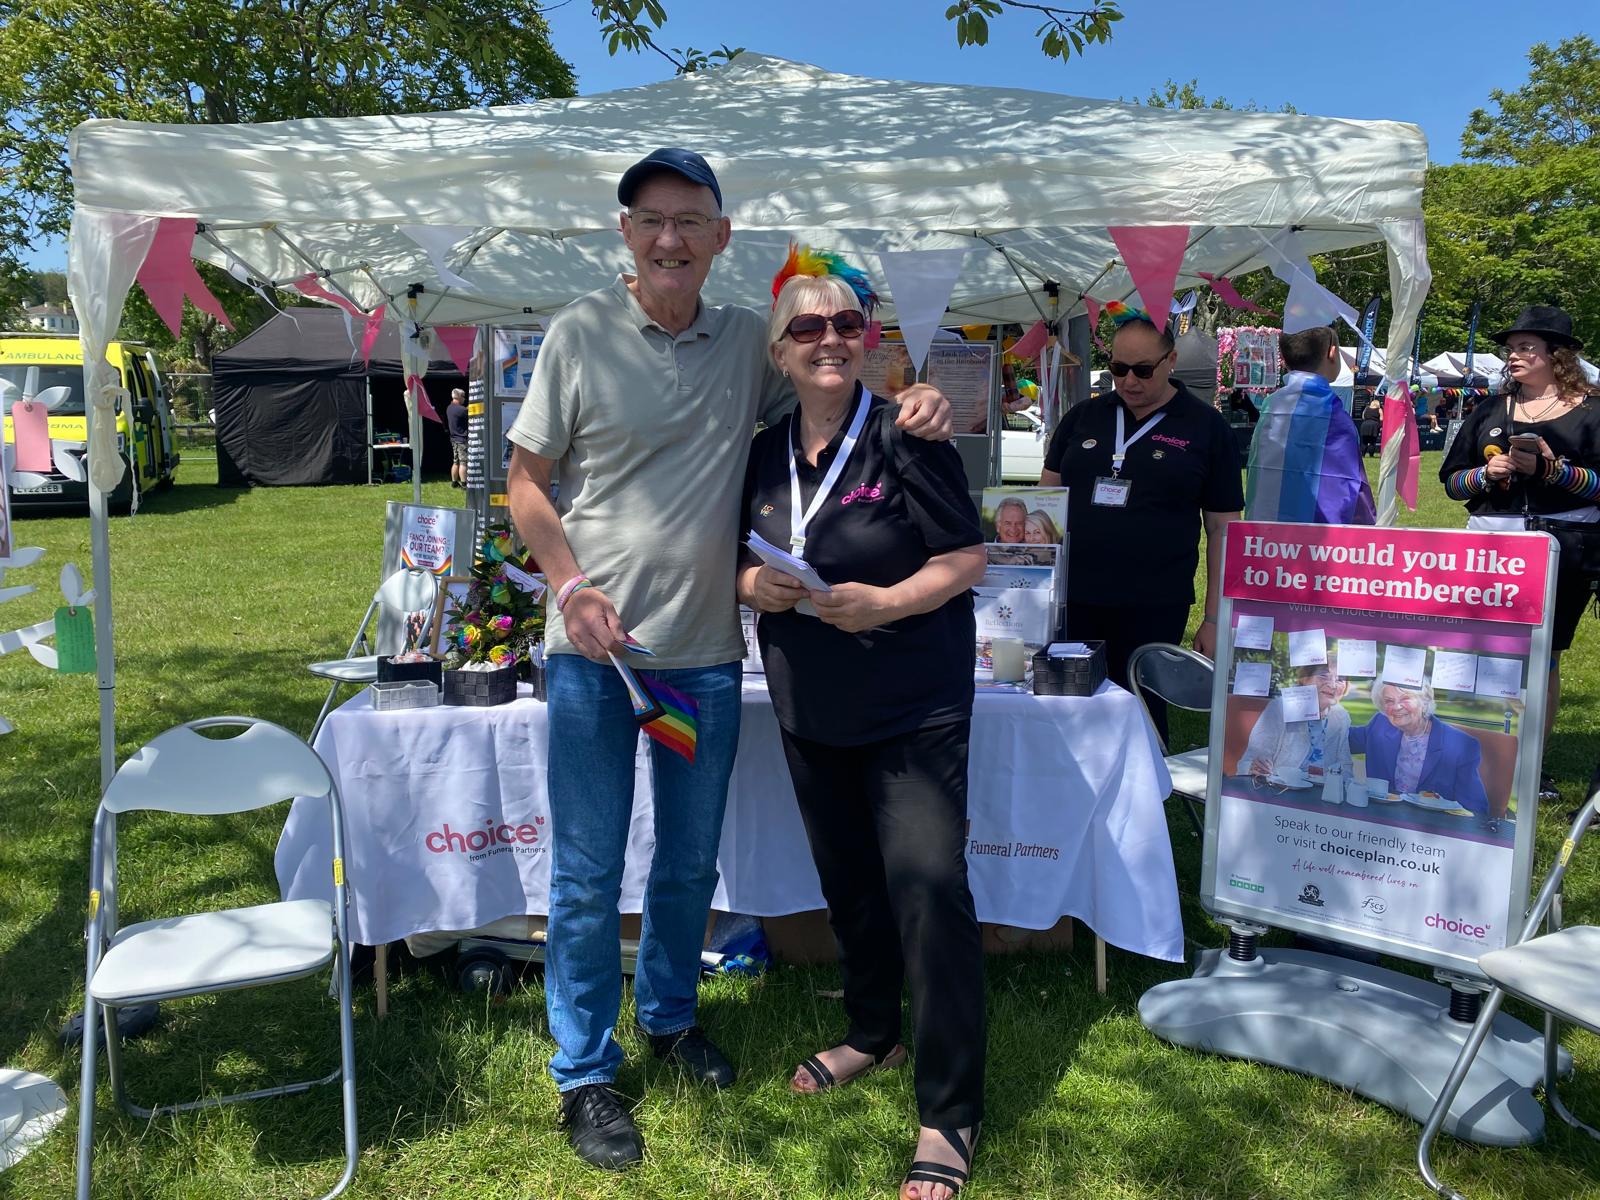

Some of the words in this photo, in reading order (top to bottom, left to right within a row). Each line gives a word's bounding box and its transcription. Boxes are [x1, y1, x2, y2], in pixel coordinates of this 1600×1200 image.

[1152, 434, 1186, 447] choice
[842, 482, 880, 504] choice
[417, 514, 435, 525] choice
[409, 533, 425, 542] FANCY
[426, 535, 447, 544] JOINING
[410, 542, 422, 551] OUR
[424, 543, 445, 555] TEAM?
[1243, 536, 1303, 560] How
[1309, 543, 1394, 566] would
[1402, 550, 1456, 573] you
[1465, 549, 1525, 575] like
[1244, 566, 1269, 586] to
[1275, 566, 1307, 590] be
[1313, 574, 1519, 607] remembered?
[425, 819, 538, 853] choice
[1275, 815, 1310, 832] Speak
[1315, 824, 1327, 835] to
[1332, 828, 1353, 840] our
[1358, 831, 1406, 853] friendly
[1411, 842, 1446, 858] team
[469, 852, 486, 862] from
[488, 846, 513, 857] Funeral
[970, 840, 1012, 857] Funeral
[1014, 842, 1060, 860] Partners
[1277, 834, 1289, 844] or
[1294, 836, 1316, 849] visit
[1320, 841, 1440, 874] choiceplan.co.uk
[1292, 858, 1301, 872] A
[1303, 860, 1316, 872] life
[1319, 863, 1335, 875] well
[1337, 869, 1385, 884] remembered
[1387, 874, 1406, 887] lives
[1424, 913, 1486, 938] choice
